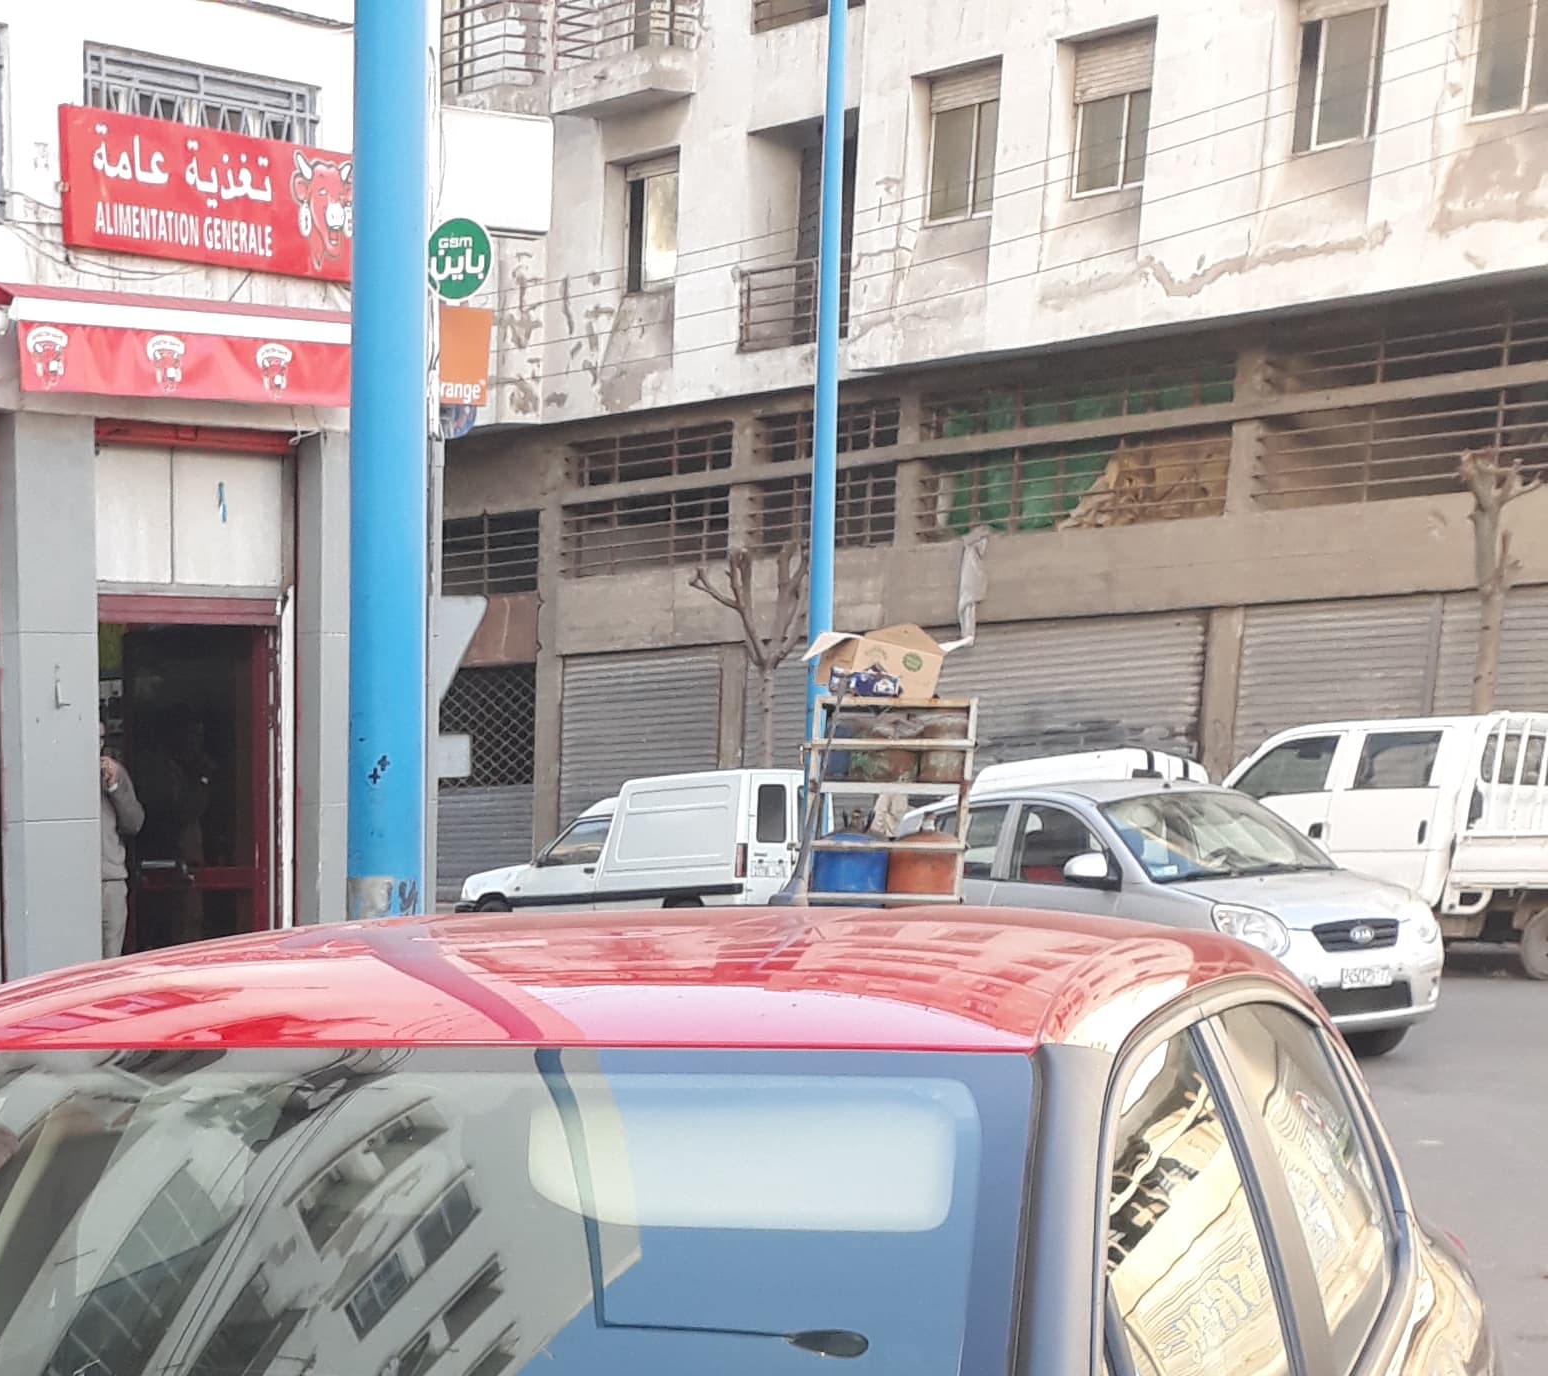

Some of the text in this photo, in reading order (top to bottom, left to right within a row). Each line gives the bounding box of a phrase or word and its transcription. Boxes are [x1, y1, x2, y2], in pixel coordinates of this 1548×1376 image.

[92, 123, 170, 185] عامة
[185, 139, 273, 209] تغذية
[94, 200, 273, 257] ALIMENTATION GENERALE
[430, 247, 485, 281] باين
[439, 381, 482, 405] range
